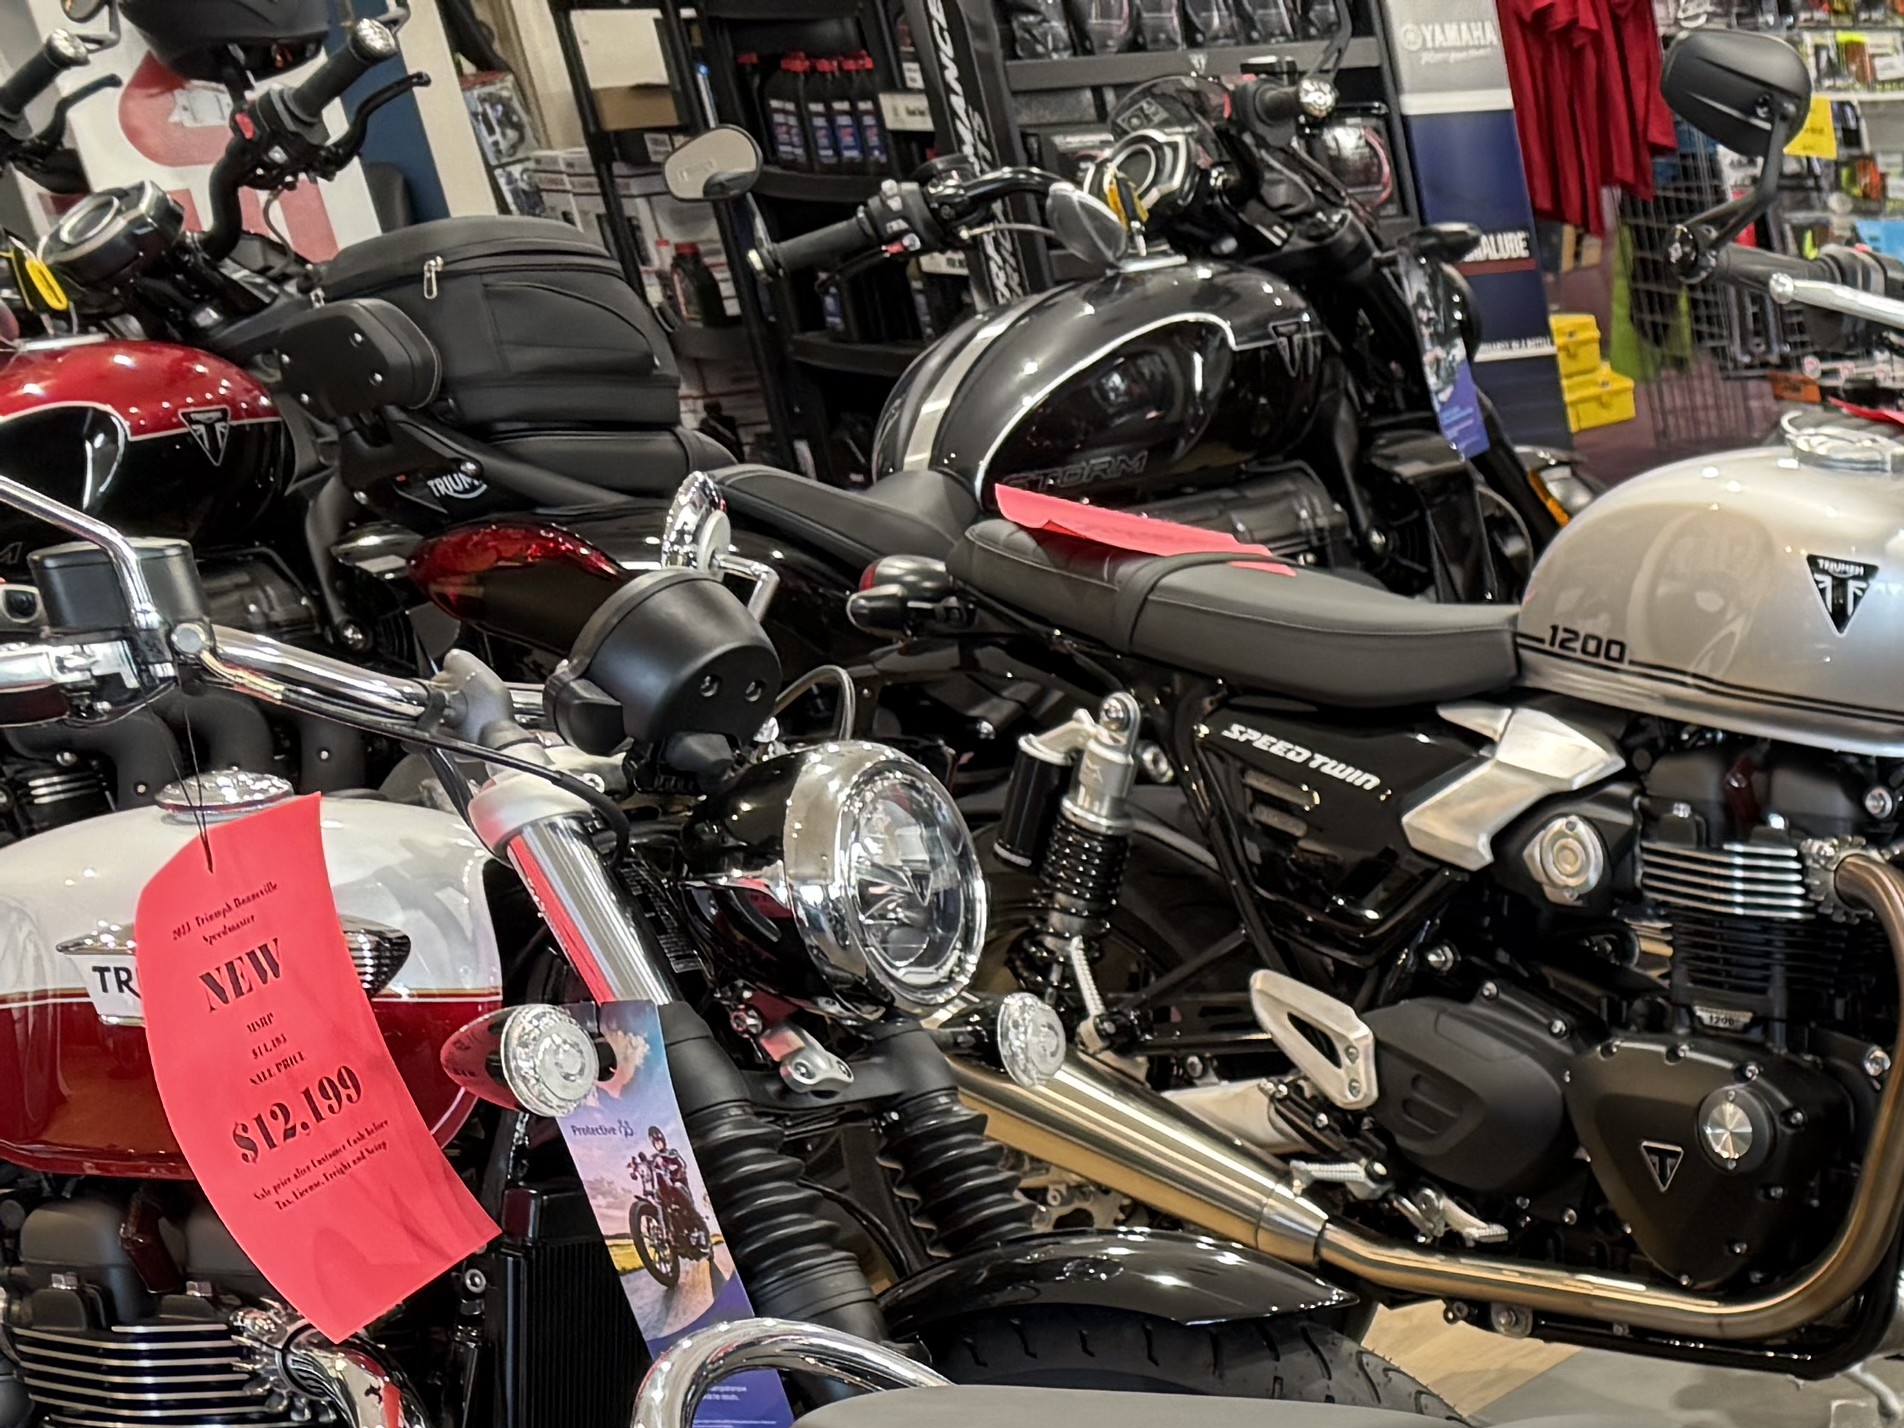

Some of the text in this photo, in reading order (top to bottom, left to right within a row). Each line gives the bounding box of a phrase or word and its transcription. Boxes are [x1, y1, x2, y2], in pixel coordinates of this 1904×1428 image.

[1421, 21, 1498, 49] YAMAHA
[427, 472, 487, 499] TRIUM
[1816, 558, 1861, 577] TRIUMPH
[1548, 624, 1626, 663] 1200
[1221, 722, 1381, 791] SPEED TWIN
[199, 938, 282, 1012] NEW
[275, 1051, 304, 1072] PRICE
[233, 1065, 361, 1164] $12,199
